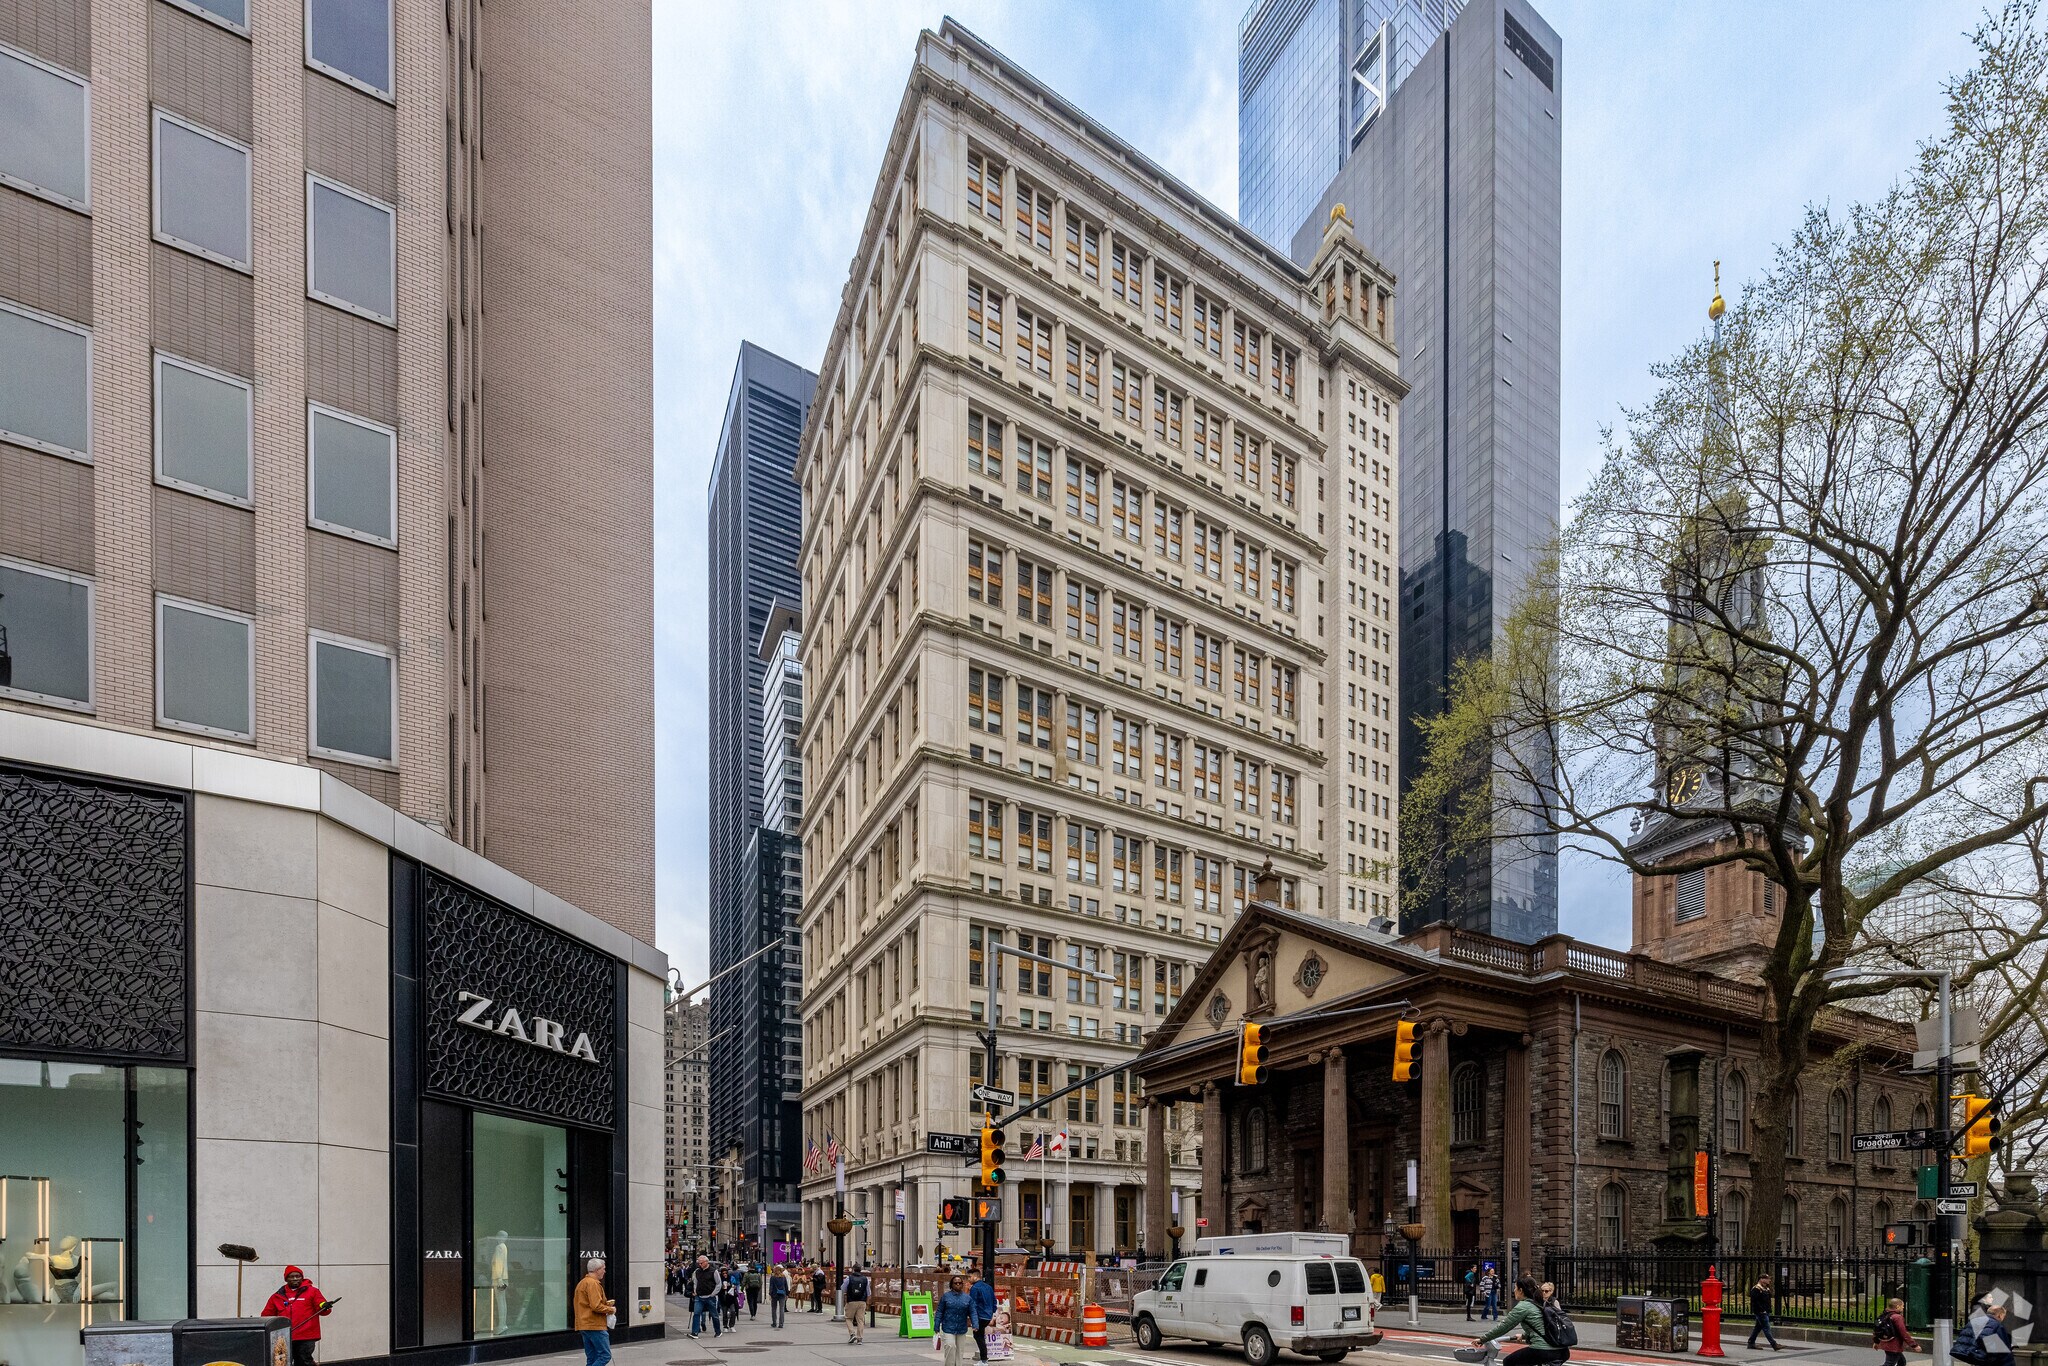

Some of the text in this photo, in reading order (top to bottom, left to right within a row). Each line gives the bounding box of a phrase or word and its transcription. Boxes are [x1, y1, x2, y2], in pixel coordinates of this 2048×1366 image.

[457, 991, 600, 1063] ZARA
[978, 1089, 991, 1098] ONE
[934, 1138, 951, 1149] Ann
[1857, 1138, 1902, 1148] Broadway
[425, 1250, 463, 1259] ZARA
[580, 1250, 607, 1258] ZARA
[988, 1334, 996, 1342] 10
